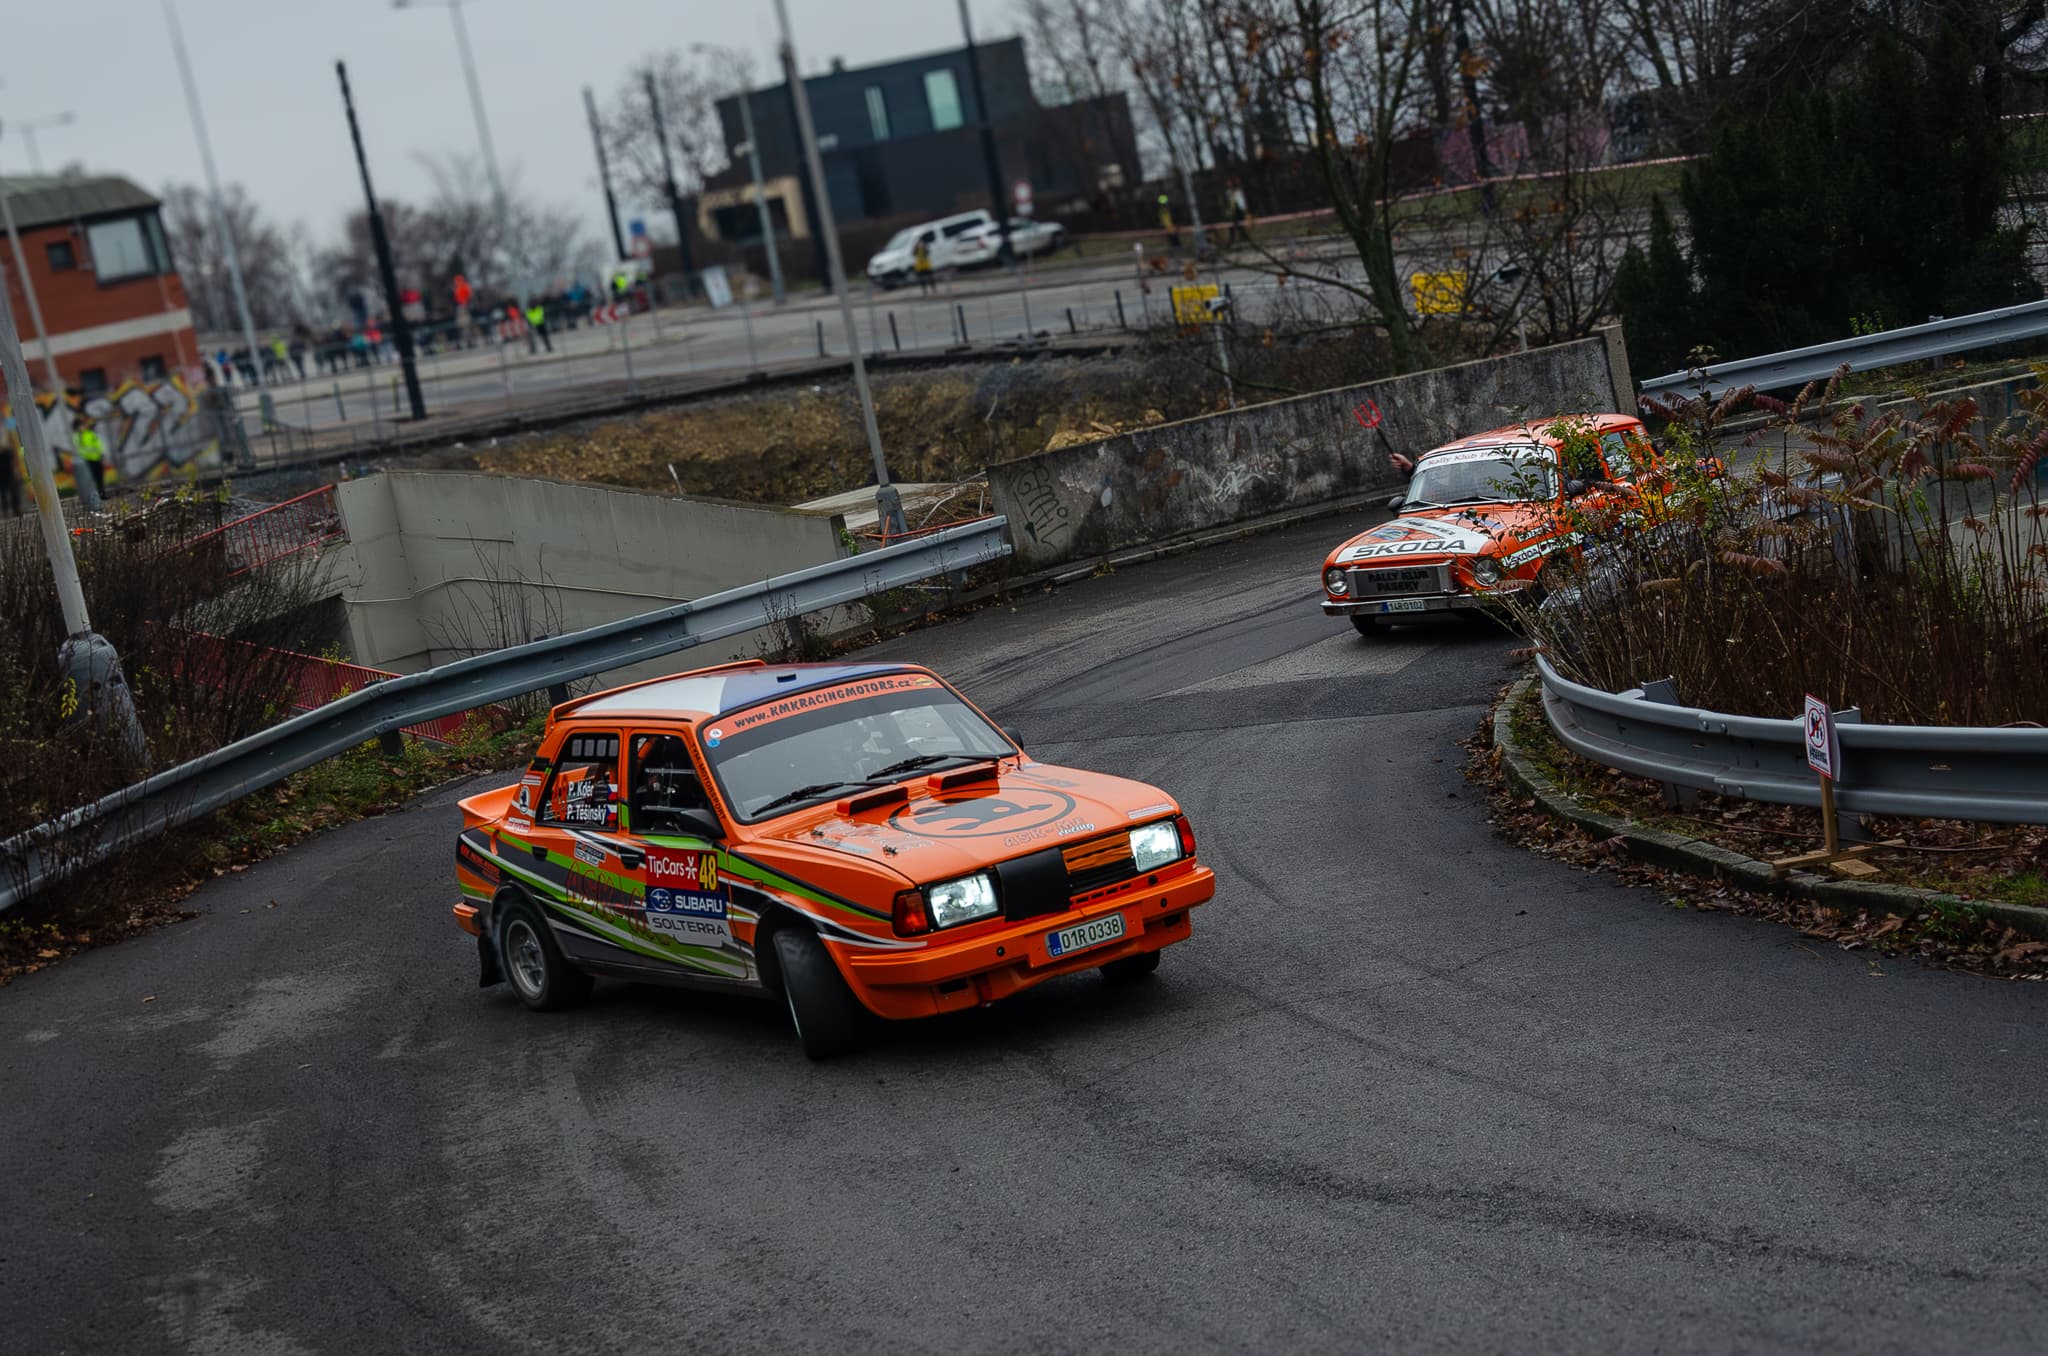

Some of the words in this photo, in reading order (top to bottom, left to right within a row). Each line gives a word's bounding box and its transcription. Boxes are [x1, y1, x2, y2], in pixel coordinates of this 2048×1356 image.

[647, 855, 685, 878] TipCars
[699, 854, 717, 890] 48
[675, 895, 722, 913] SUBARU
[652, 917, 727, 936] SOLTERRA
